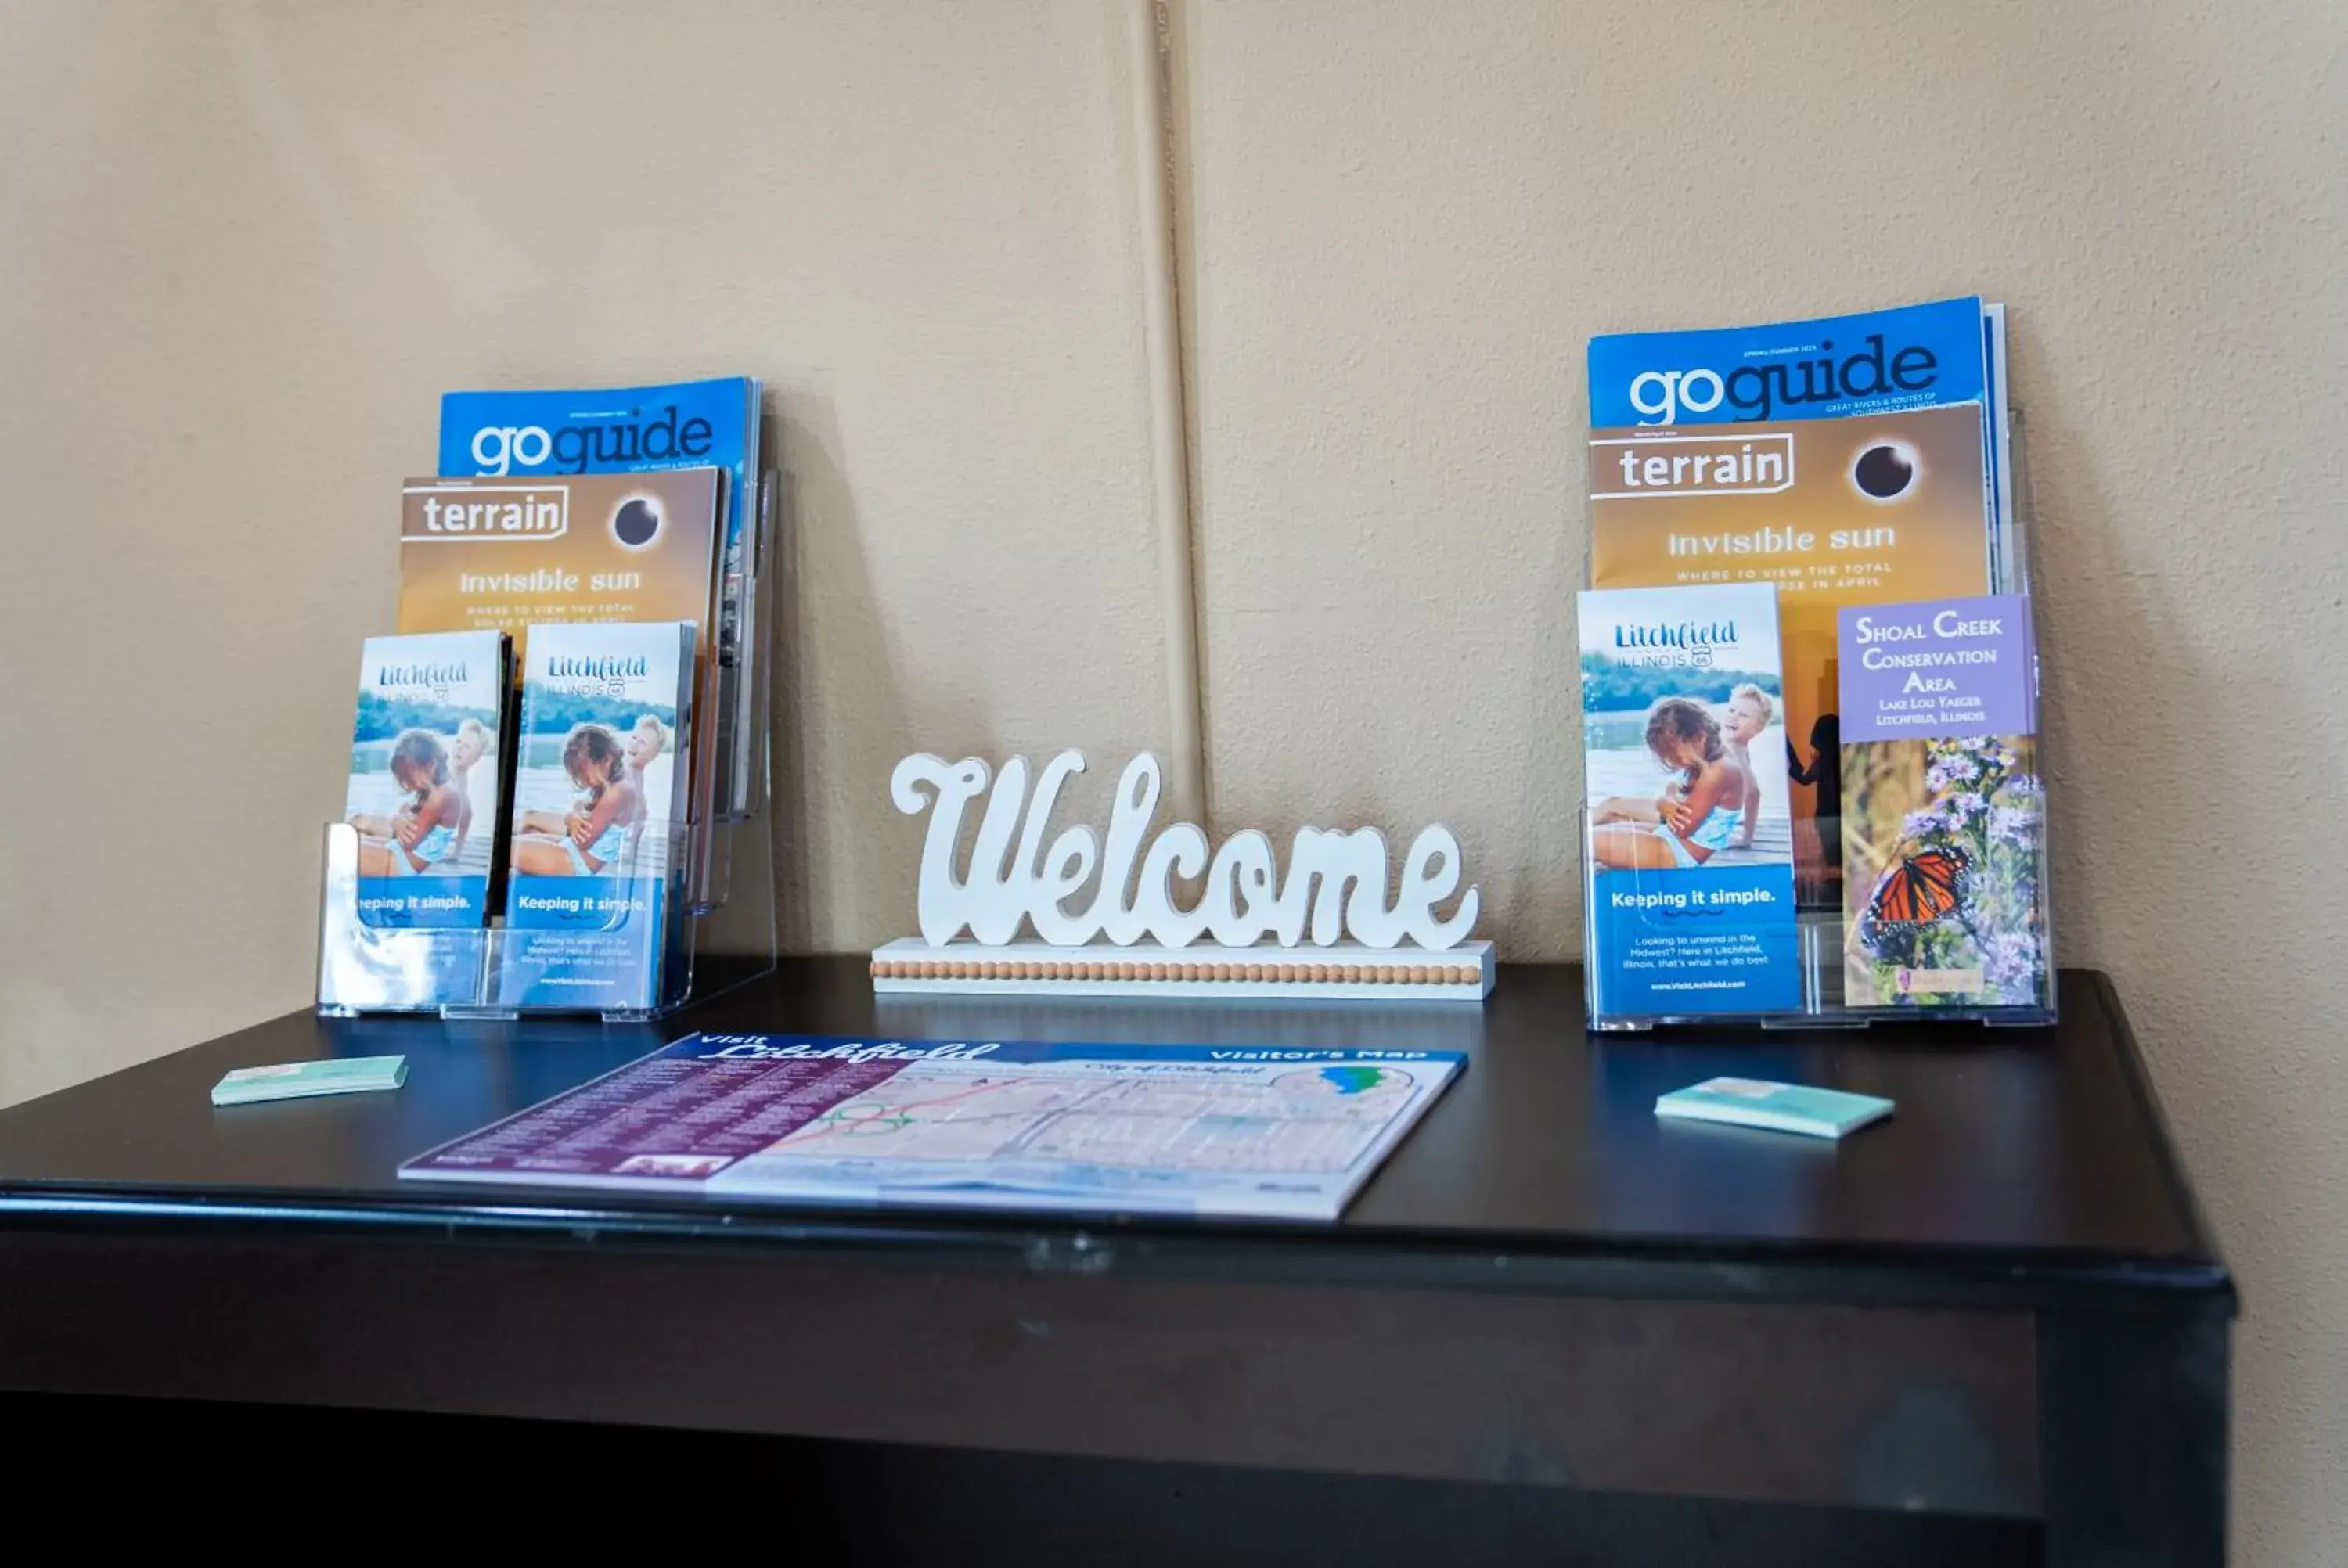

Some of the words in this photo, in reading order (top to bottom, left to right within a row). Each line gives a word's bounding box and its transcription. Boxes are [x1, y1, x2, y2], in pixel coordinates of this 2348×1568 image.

[1619, 444, 1783, 486] terrain
[423, 494, 559, 531] terrain
[1829, 526, 1896, 550] sun
[590, 571, 640, 592] sun
[1676, 569, 1730, 582] WHERE
[1737, 568, 1756, 580] TO
[1763, 566, 1802, 578] VIEW
[1809, 565, 1837, 576] THE
[1845, 563, 1892, 574] TOTAL
[1812, 578, 1828, 589] IN
[1615, 620, 1739, 649] Litchfield
[1856, 616, 1926, 644] SHOAL
[1933, 610, 2003, 638] CREEK
[549, 655, 646, 681] Litchfield
[1617, 653, 1686, 668] ILLINOIS
[1862, 647, 1997, 670] CONSERVATION
[380, 663, 467, 687] Litchfield
[1903, 671, 1957, 694] AREA
[890, 746, 1481, 948] Welcome
[407, 896, 416, 908] it
[422, 895, 471, 911] simple.
[519, 895, 579, 912] Keeping
[583, 897, 593, 909] it
[597, 897, 647, 912] simple.
[1612, 890, 1687, 908] Keeping
[1692, 890, 1705, 904] it
[1710, 887, 1776, 908] simple.
[1635, 937, 1674, 947] Looking
[1677, 936, 1687, 944] to
[1690, 934, 1727, 944] unwind
[1630, 948, 1676, 958] Midwest?
[1678, 947, 1701, 956] Here
[1703, 947, 1712, 955] in
[1658, 958, 1685, 968] that's
[1688, 958, 1712, 967] what
[1730, 956, 1745, 966] do
[700, 1035, 768, 1045] Visit
[698, 1041, 1000, 1063] Litchfield
[1210, 1049, 1345, 1059] Visitor's
[1356, 1050, 1428, 1060] Map
